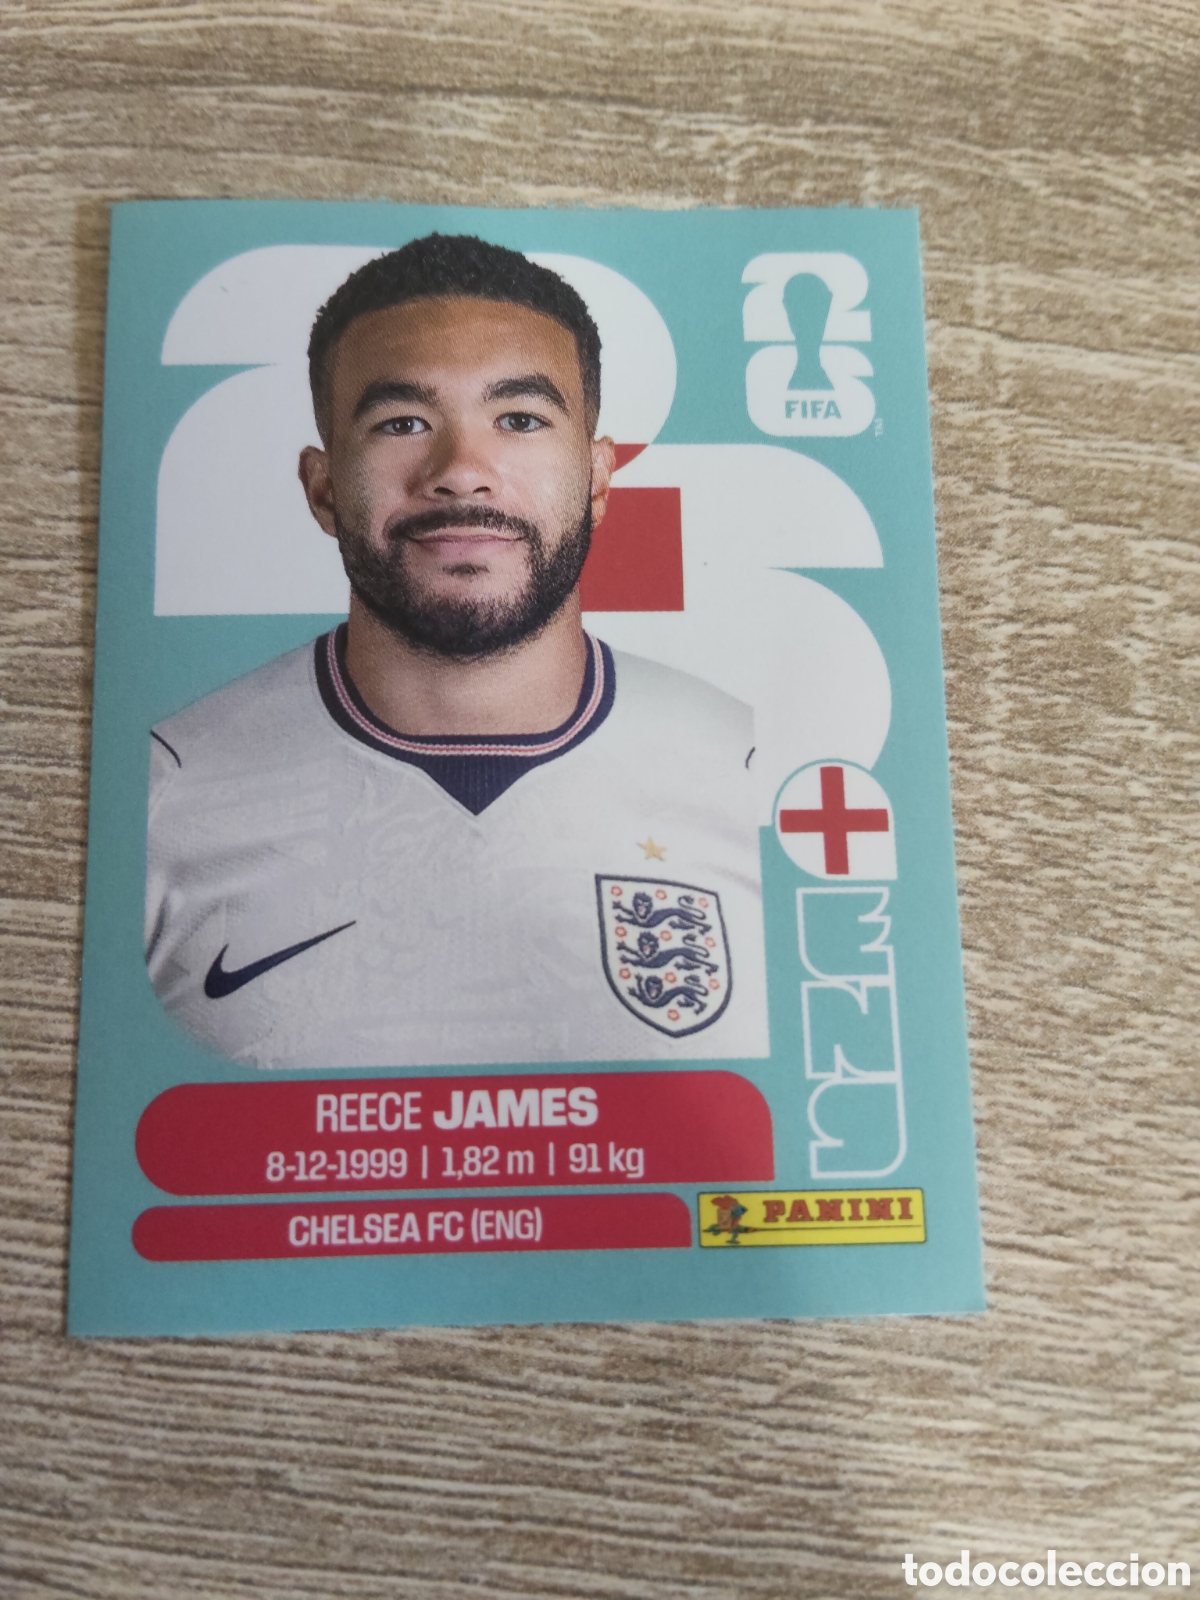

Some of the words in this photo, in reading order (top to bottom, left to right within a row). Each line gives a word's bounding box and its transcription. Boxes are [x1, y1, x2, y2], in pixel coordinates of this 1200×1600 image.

[784, 400, 842, 420] FIFA
[316, 1091, 422, 1133] REECE
[433, 1086, 599, 1130] JAMES
[265, 1148, 408, 1183] 8-12-1999
[441, 1145, 500, 1180] 1,82
[506, 1149, 535, 1175] m
[568, 1143, 602, 1173] 91
[608, 1141, 645, 1178] kg
[288, 1212, 421, 1247] CHELSEA
[427, 1211, 465, 1242] FC
[470, 1206, 543, 1243] (ENG)
[762, 1197, 914, 1223] PANINI
